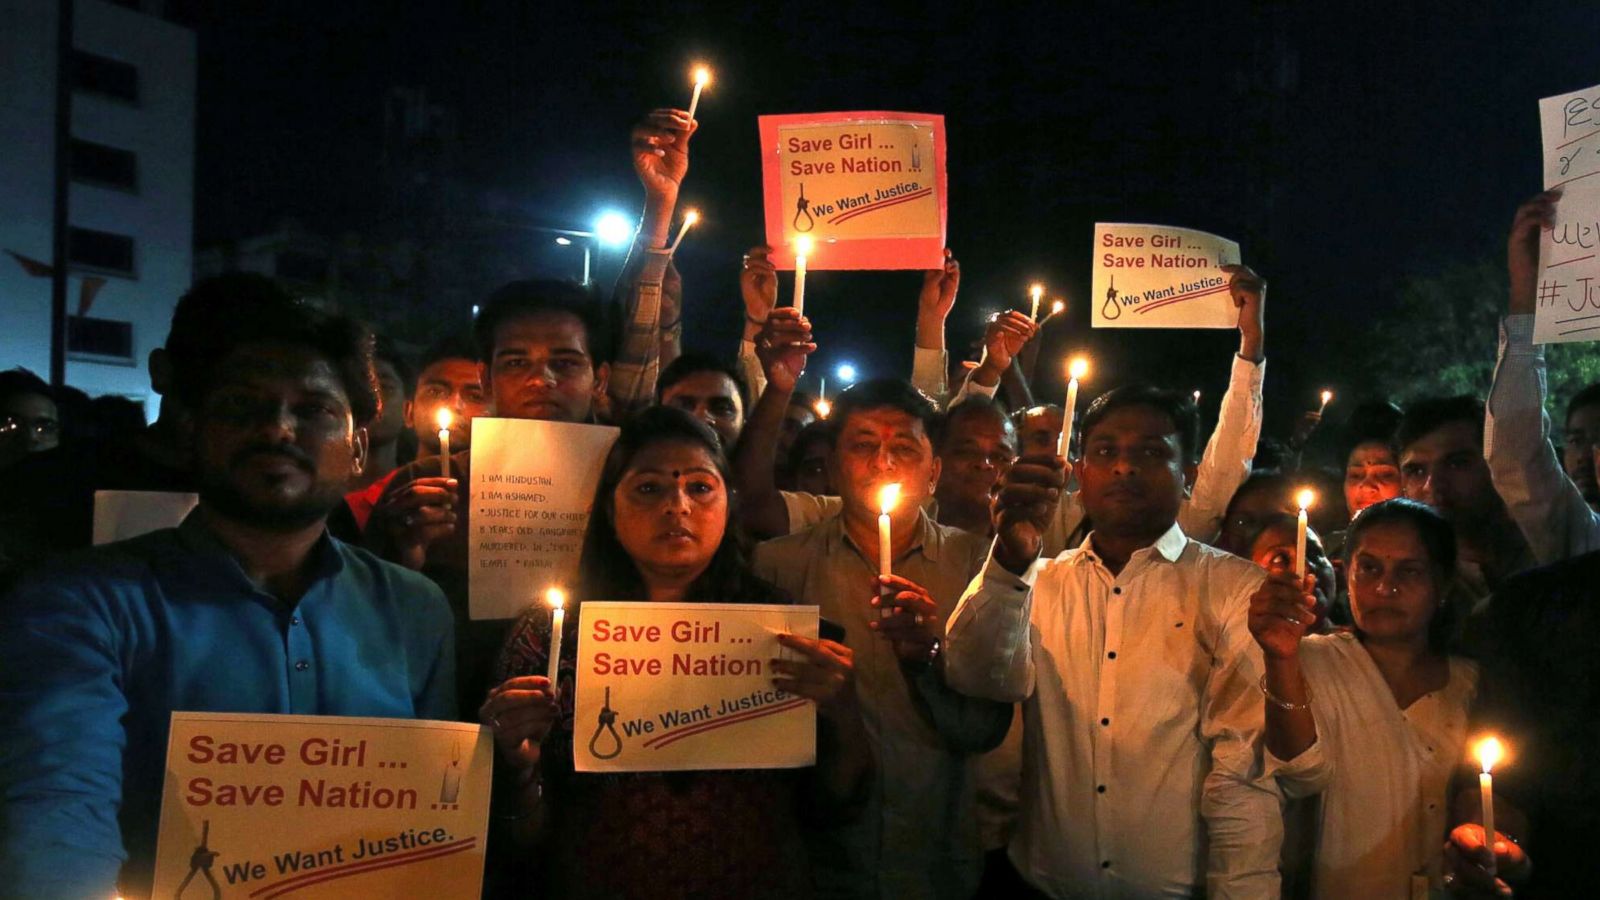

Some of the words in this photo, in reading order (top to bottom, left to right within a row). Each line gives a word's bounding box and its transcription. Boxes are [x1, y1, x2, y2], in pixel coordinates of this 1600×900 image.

[789, 137, 832, 153] Save
[839, 134, 872, 150] Girl
[791, 160, 835, 176] Save
[842, 157, 902, 173] Nation
[812, 205, 834, 218] We
[836, 193, 871, 211] Want
[874, 181, 922, 201] Justice.
[1103, 233, 1144, 248] Save
[1150, 234, 1181, 248] Girl
[1103, 253, 1145, 268] Save
[1151, 253, 1208, 268] Nation
[1120, 295, 1140, 307] We
[1143, 286, 1175, 301] Want
[1178, 275, 1227, 294] Justice.
[489, 474, 502, 483] AM
[488, 491, 502, 500] AM
[524, 510, 538, 519] FOR
[541, 511, 556, 520] OUR
[489, 525, 514, 535] YEARS
[517, 526, 533, 535] OLD
[592, 619, 661, 644] Save
[671, 620, 720, 644] Girl
[593, 652, 662, 676] Save
[672, 653, 761, 676] Nation
[622, 719, 654, 738] We
[659, 706, 712, 729] Want
[717, 689, 791, 716] Justice.
[187, 735, 286, 765] Save
[300, 738, 366, 768] Girl
[186, 777, 285, 807] Save
[298, 779, 417, 810] Nation
[223, 862, 266, 885] We
[274, 845, 344, 875] Want
[351, 826, 453, 859] Justice.
